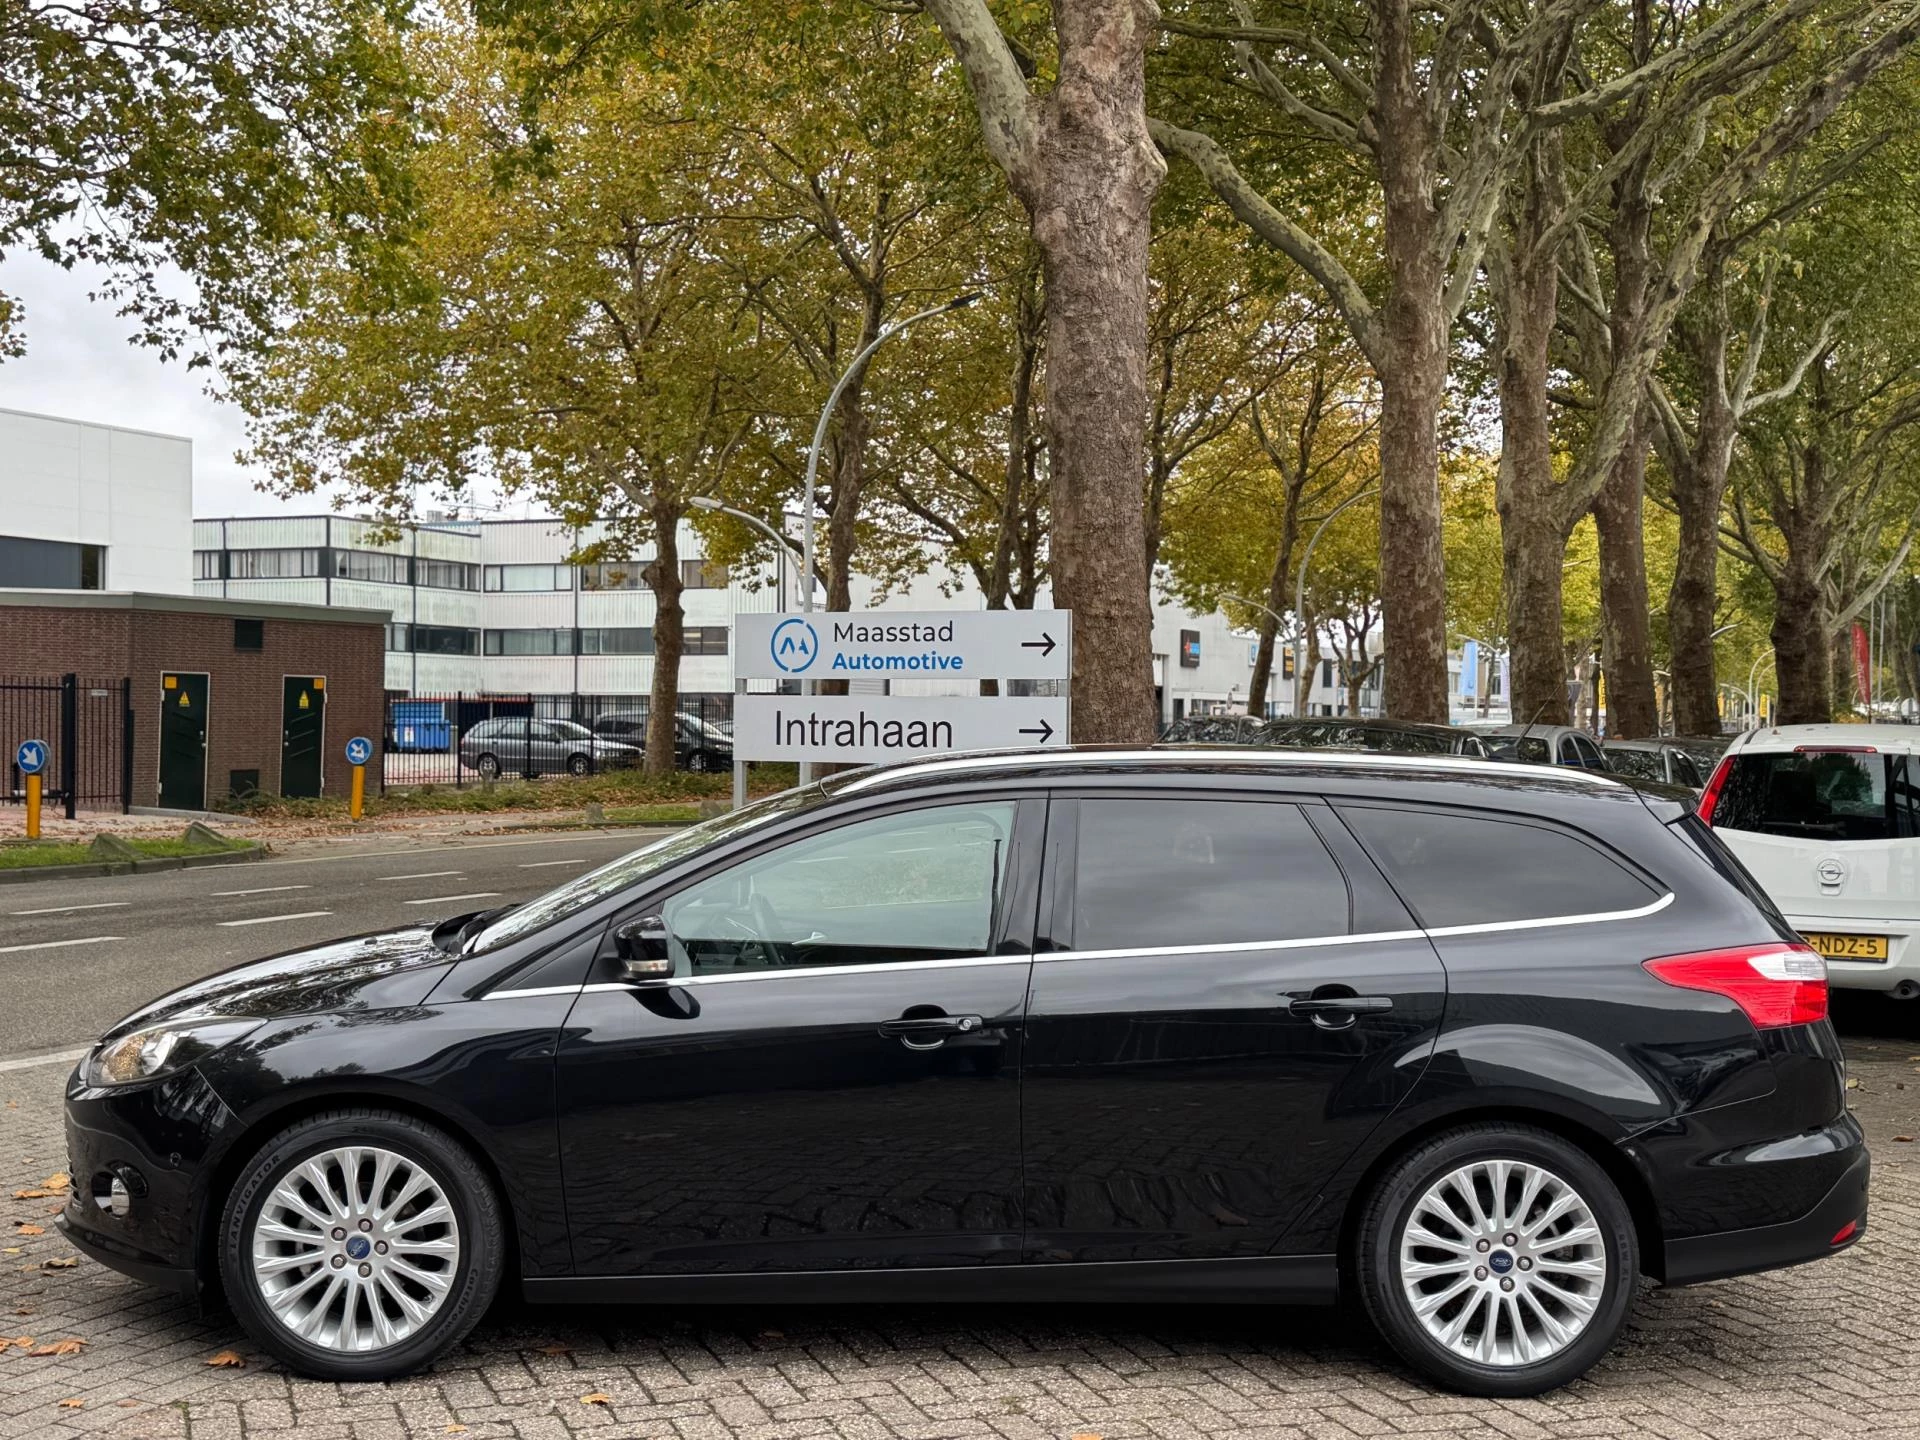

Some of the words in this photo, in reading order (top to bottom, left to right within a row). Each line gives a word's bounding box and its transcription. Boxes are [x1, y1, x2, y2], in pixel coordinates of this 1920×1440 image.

[833, 620, 953, 643] Maasstad
[832, 651, 963, 671] Automotive
[776, 710, 952, 749] Intrahaan
[229, 1154, 280, 1250] LANVIGATOR
